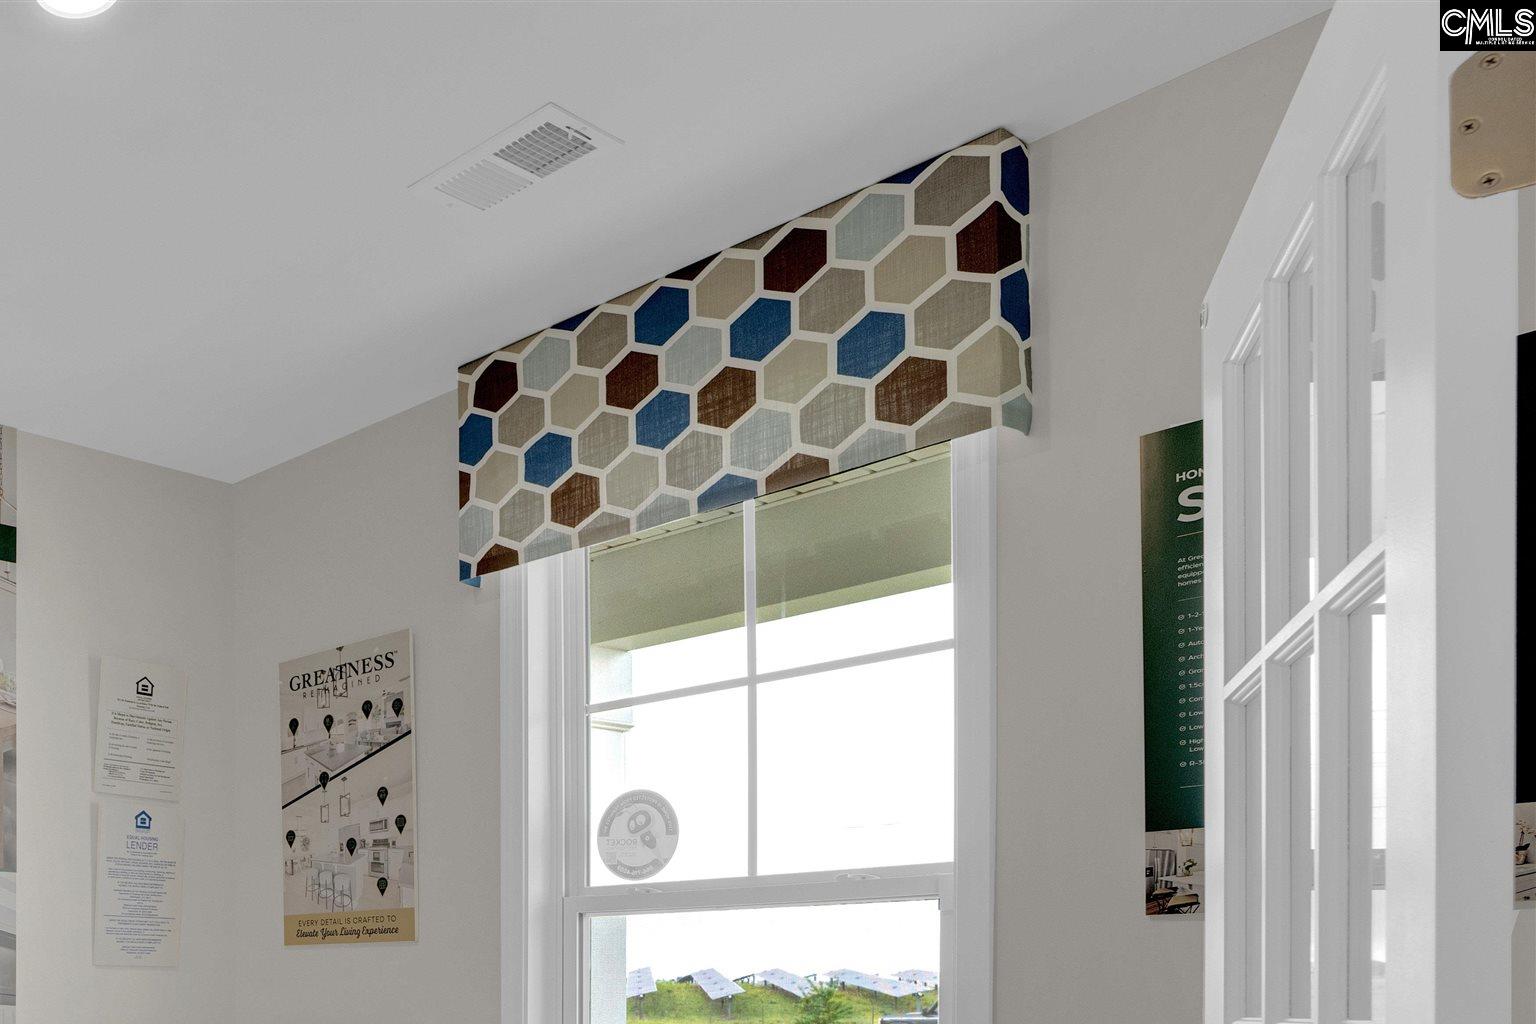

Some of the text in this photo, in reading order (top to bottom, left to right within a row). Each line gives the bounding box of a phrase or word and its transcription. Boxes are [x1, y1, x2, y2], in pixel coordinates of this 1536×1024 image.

[1188, 611, 1204, 619] 1-2-
[303, 674, 381, 699] REIMAGINED
[1189, 759, 1204, 767] R-3
[126, 840, 159, 851] LENDER
[298, 919, 318, 928] EVERY
[320, 918, 343, 926] DETAIL
[353, 915, 385, 924] CRAFTED
[387, 914, 396, 922] TO
[296, 925, 399, 940] Elevate Your Living Experience
